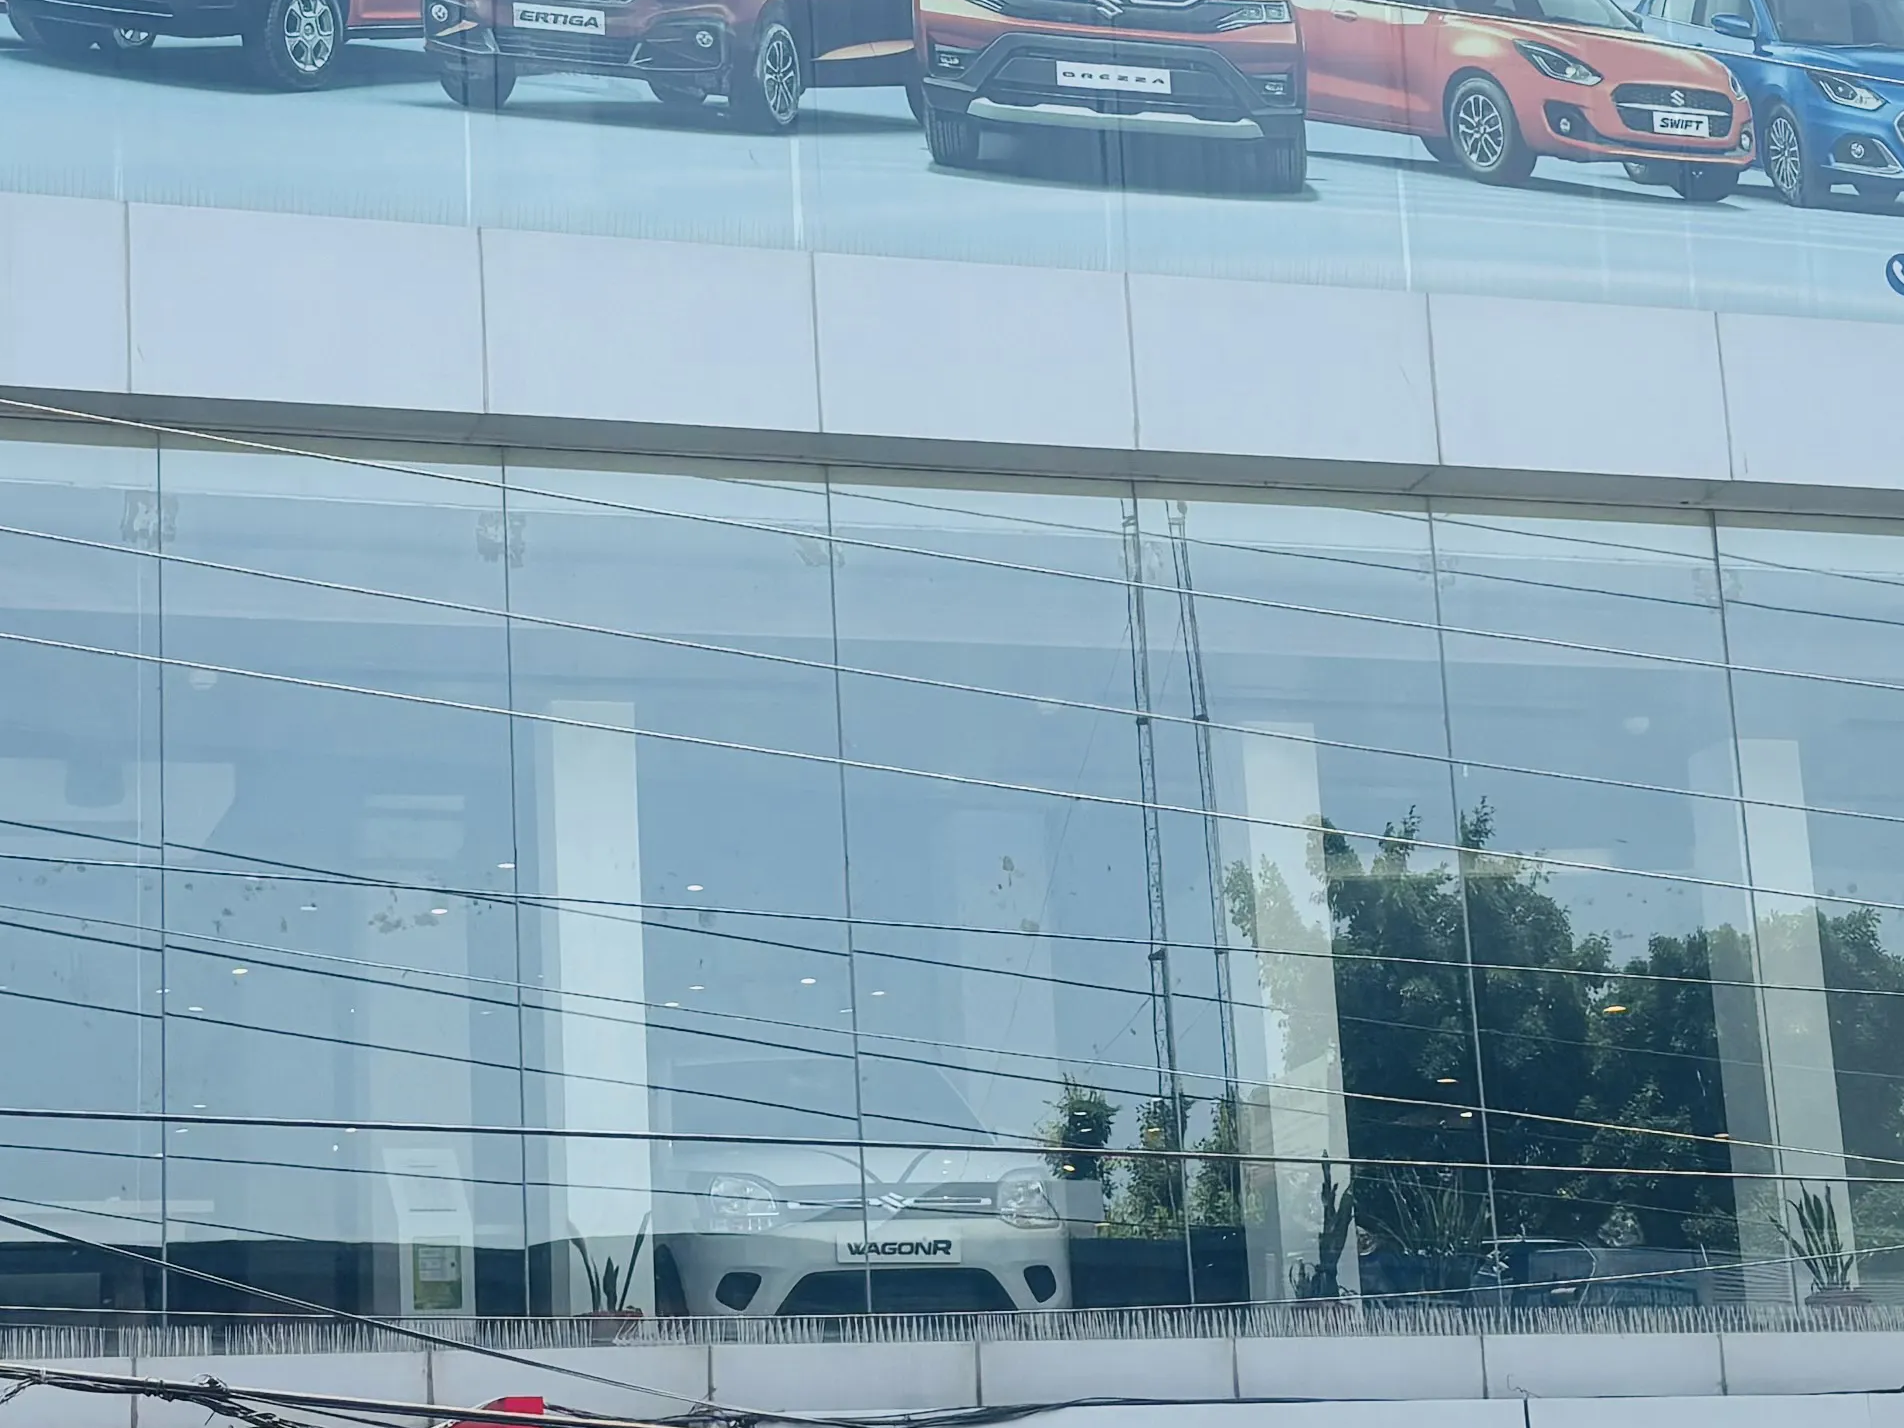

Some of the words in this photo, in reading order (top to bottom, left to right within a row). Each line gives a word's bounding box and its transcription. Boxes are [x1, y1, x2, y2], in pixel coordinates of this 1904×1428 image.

[518, 11, 601, 29] ERTIGA
[1657, 116, 1705, 133] SWIFT
[847, 1238, 952, 1257] WAGONR
